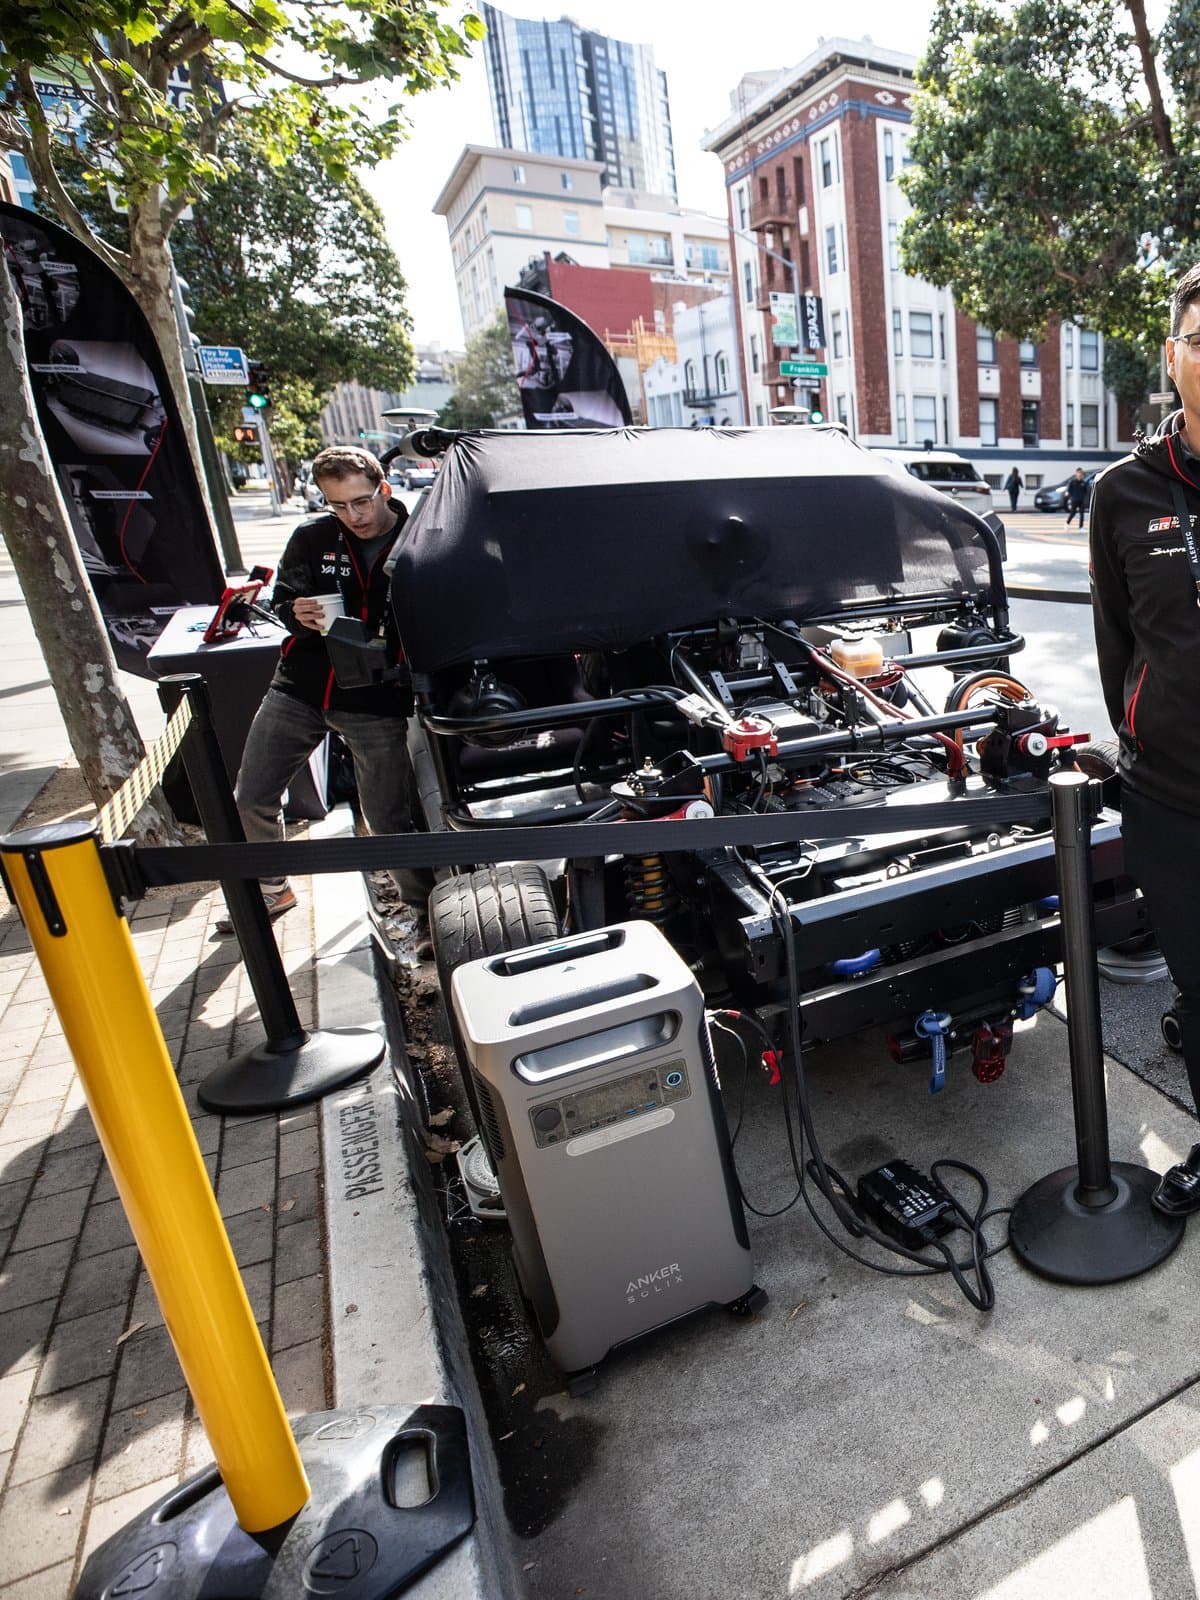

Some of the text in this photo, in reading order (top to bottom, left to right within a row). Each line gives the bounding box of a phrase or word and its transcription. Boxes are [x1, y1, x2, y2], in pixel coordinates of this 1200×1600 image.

[806, 296, 820, 349] SFJAZZ
[790, 365, 820, 374] Franklin
[1185, 531, 1199, 564] ALEPHIC
[339, 1100, 384, 1201] PASSENGER
[625, 1263, 681, 1295] ANKER
[627, 1274, 684, 1305] SOLIX
